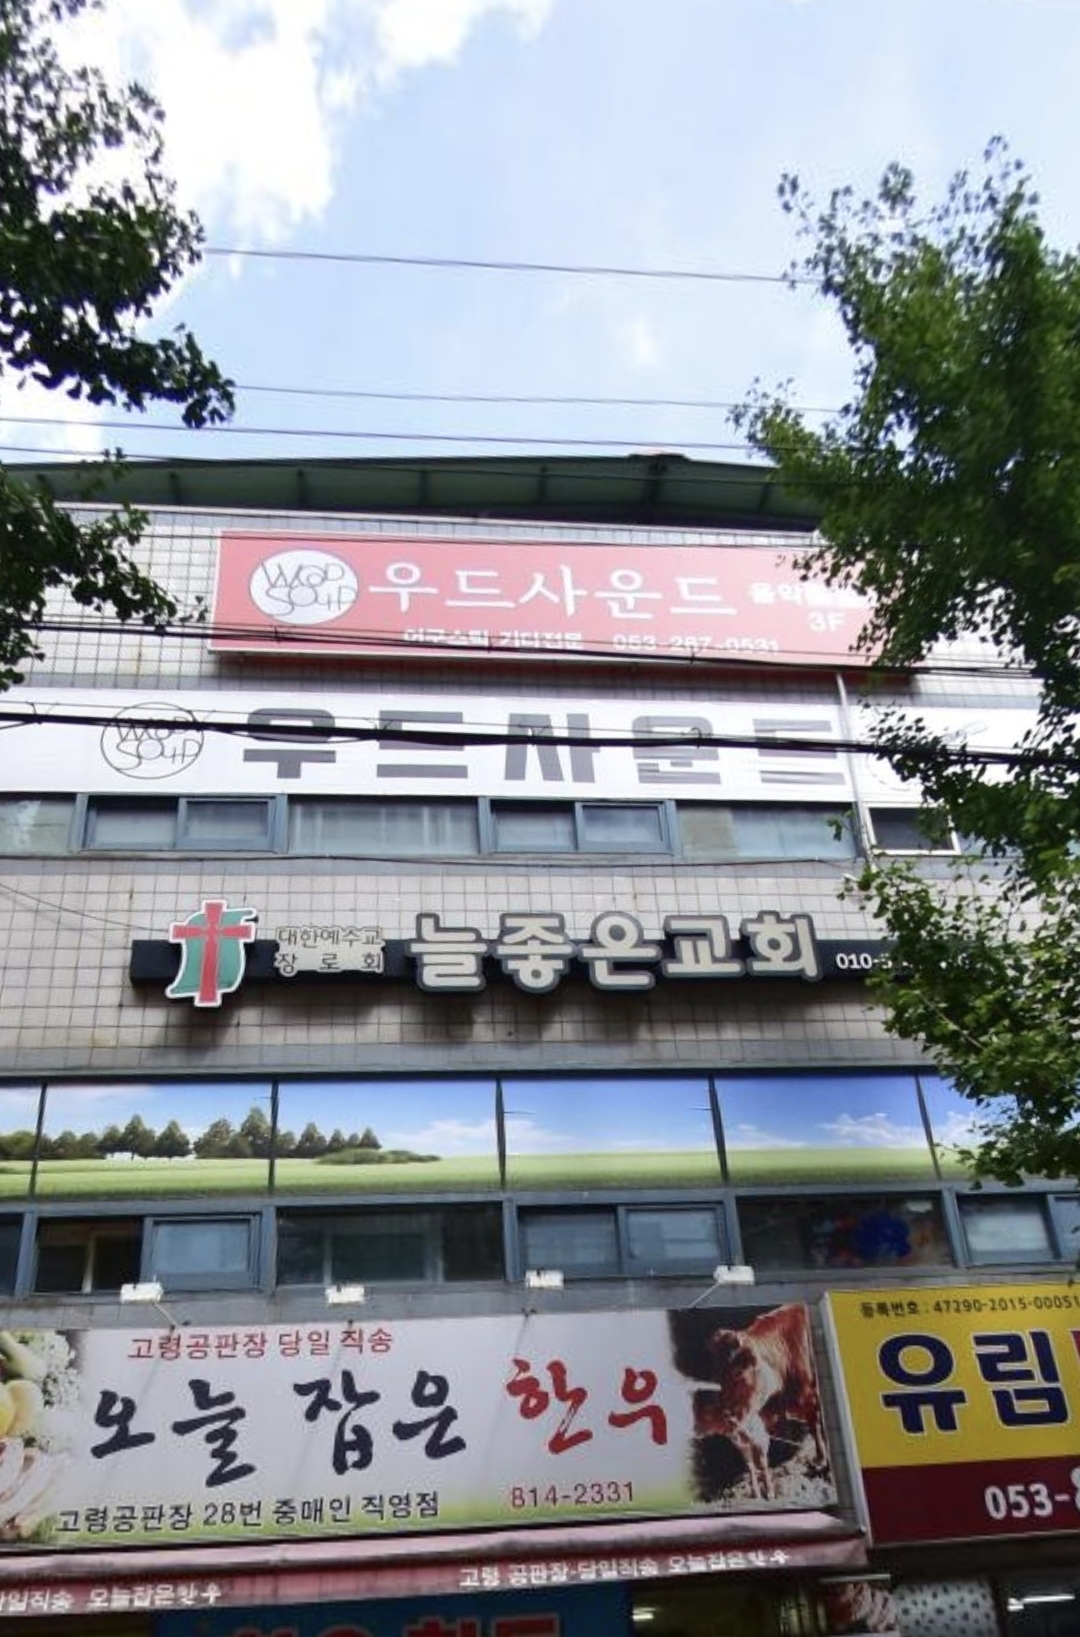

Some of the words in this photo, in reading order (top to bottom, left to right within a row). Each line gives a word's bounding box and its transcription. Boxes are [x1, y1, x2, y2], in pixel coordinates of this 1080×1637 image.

[367, 561, 738, 619] 우드사운드
[807, 611, 846, 632] 3F
[243, 708, 847, 786] 우드사운드
[276, 926, 384, 946] 대한예수교
[408, 912, 819, 988] 늘좋은교회
[127, 1333, 268, 1361] 고령공판장
[278, 1331, 330, 1357] 당일
[340, 1327, 393, 1355] 직송
[90, 1379, 256, 1488] 오늘
[293, 1369, 467, 1475] 잡은
[506, 1359, 668, 1455] 한우
[55, 1503, 194, 1534] 고령공판장
[202, 1501, 263, 1528] 28번
[272, 1496, 352, 1525] 중매인
[361, 1490, 440, 1521] 직영점
[511, 1480, 634, 1508] 814-2331
